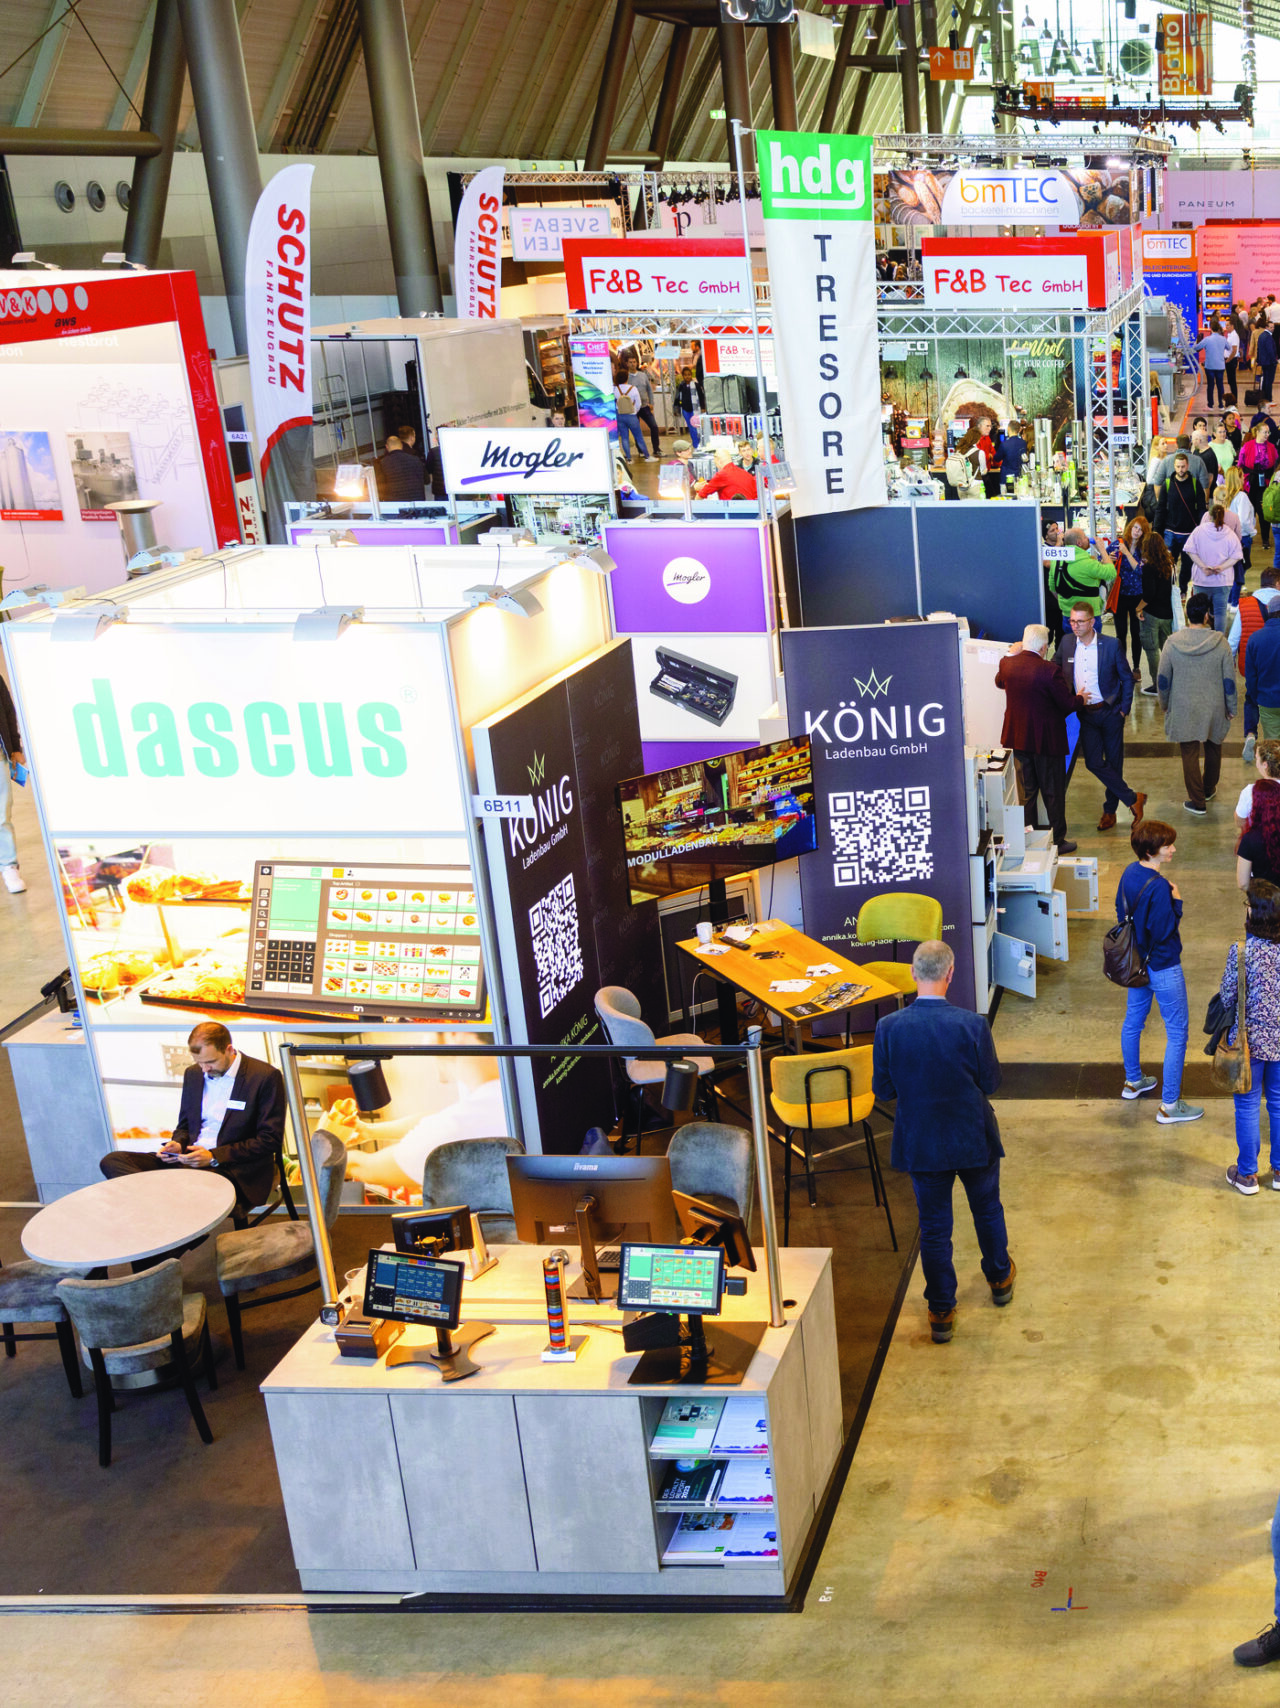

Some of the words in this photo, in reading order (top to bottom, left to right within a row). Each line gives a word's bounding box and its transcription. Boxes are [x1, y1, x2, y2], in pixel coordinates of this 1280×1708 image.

[1162, 20, 1182, 95] Bistro
[769, 141, 865, 209] hdg
[960, 177, 1059, 203] bmTEC
[477, 192, 499, 319] SCHUTZ
[1146, 237, 1188, 250] bmTEC
[277, 203, 306, 393] SCHUTZ
[589, 269, 643, 295] F&B
[651, 275, 689, 294] Tec
[698, 280, 740, 294] GmbH
[934, 268, 987, 295] F&B
[995, 275, 1032, 293] Tec
[1042, 279, 1083, 293] GmbH
[54, 317, 77, 328] aws
[265, 259, 277, 385] FAHRZEUGBAU
[813, 234, 845, 495] TRESORE
[1113, 435, 1130, 443] 6B21
[480, 438, 584, 479] Mogler
[1044, 547, 1069, 559] 6B13
[673, 571, 706, 585] Mogler
[72, 678, 409, 778] dascus
[804, 701, 946, 744] KÖNIG
[825, 746, 886, 760] Ladenbau
[889, 743, 928, 756] GmbH
[484, 800, 521, 812] 6B11
[522, 840, 551, 870] Ladenbau
[550, 823, 569, 846] GmbH
[627, 835, 718, 868] MODULLADENBAU
